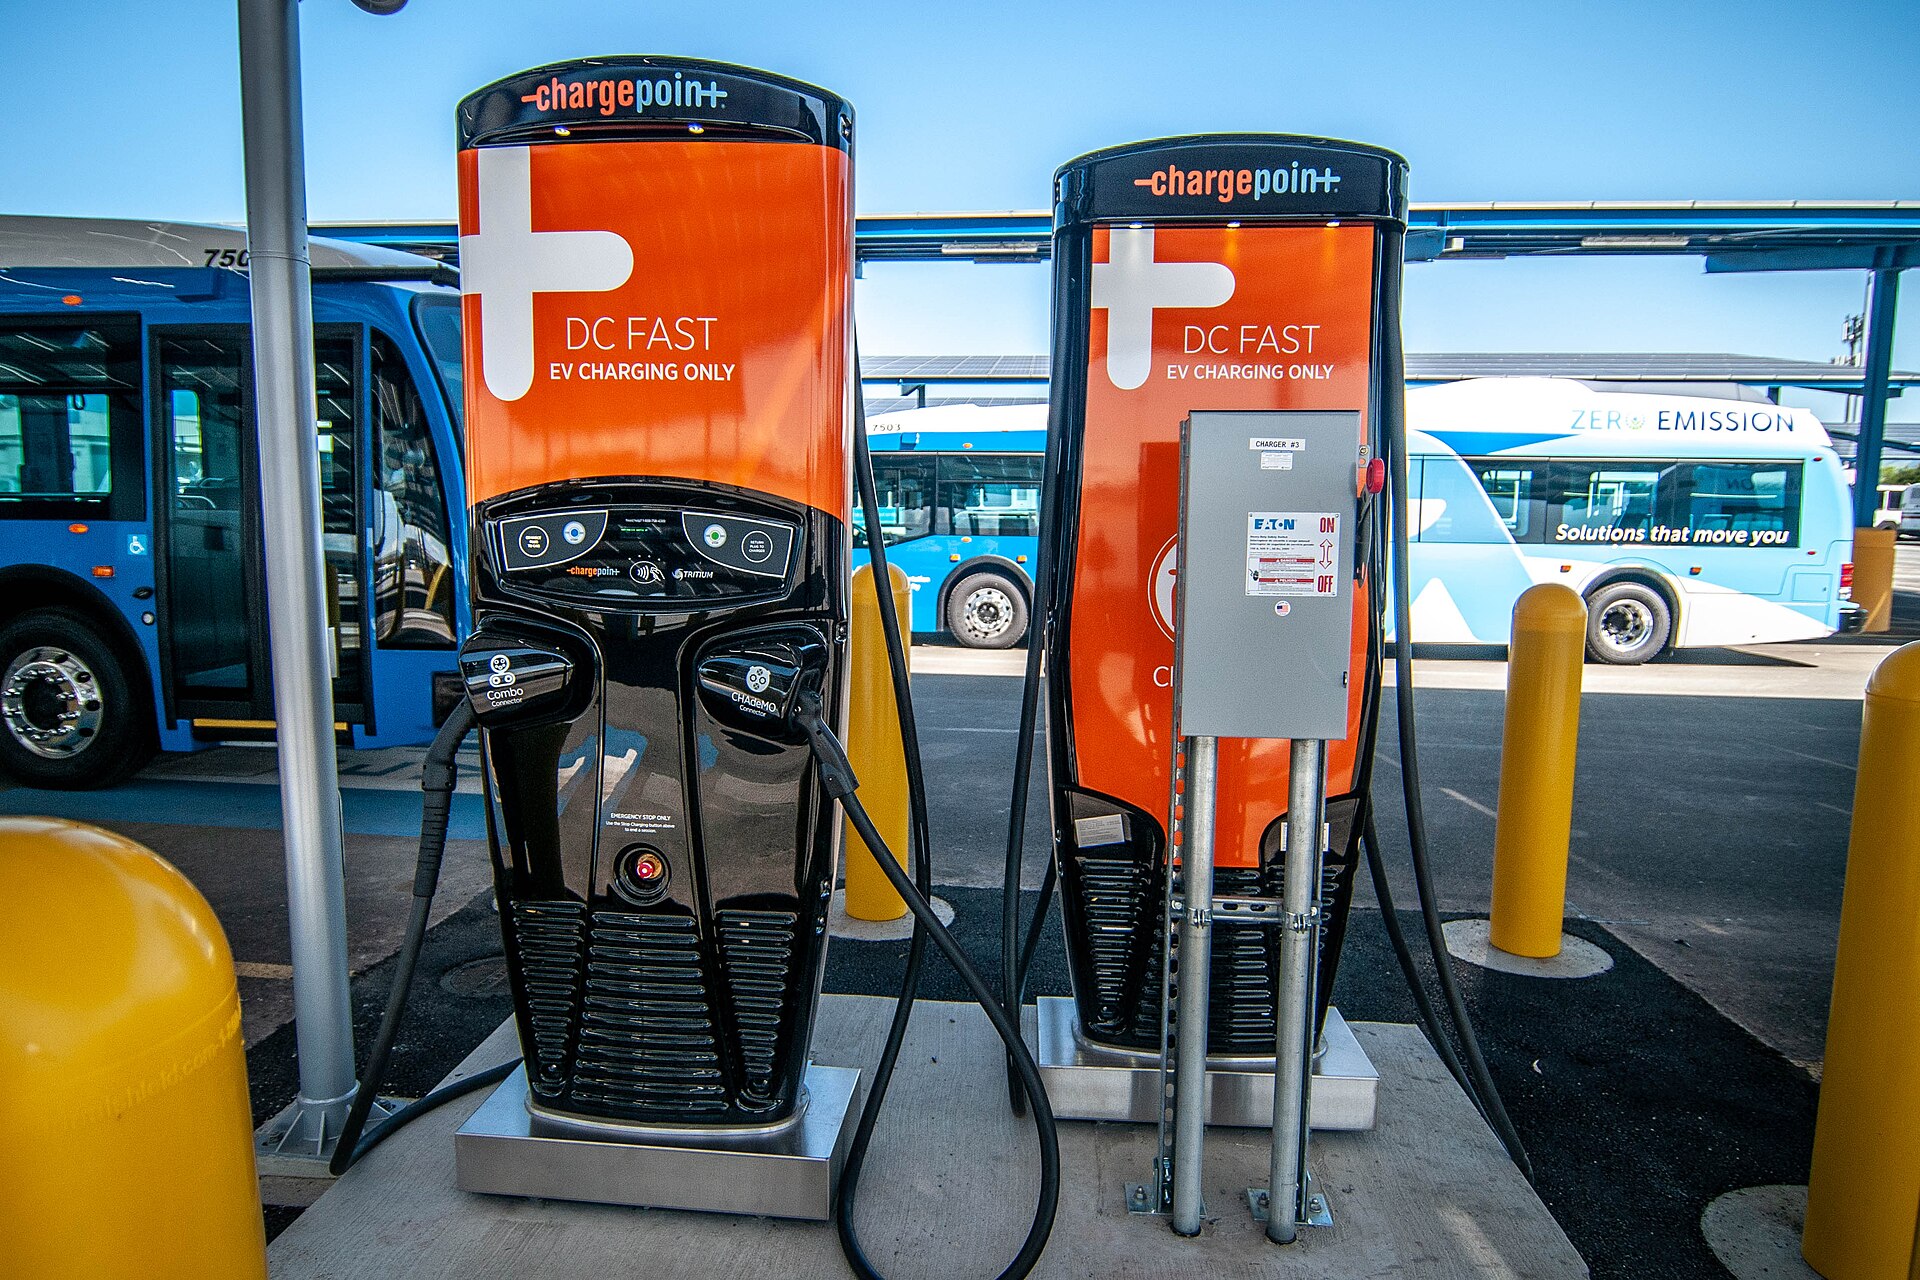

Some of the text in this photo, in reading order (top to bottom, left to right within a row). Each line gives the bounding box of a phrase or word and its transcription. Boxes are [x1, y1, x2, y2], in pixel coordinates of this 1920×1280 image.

[521, 72, 728, 115] chargepoint
[1134, 161, 1341, 202] chargepoint
[566, 317, 718, 351] DC FAST
[1183, 325, 1321, 354] DC FAST
[550, 362, 736, 381] EV CHARGING ONLY
[1167, 364, 1334, 380] EV CHARGING ONLY
[872, 423, 901, 431] 7503
[1658, 410, 1794, 432] EMISSION
[1255, 440, 1287, 448] CHARGER
[1254, 518, 1295, 530] EATON
[1319, 517, 1335, 533] ON
[1555, 523, 1790, 547] Solutions that move you
[566, 566, 620, 578] chargepoint
[683, 570, 714, 579] TRITIUM
[1317, 575, 1334, 593] OFF
[486, 687, 524, 701] Combo
[731, 691, 777, 713] CHAdeMO
[491, 697, 523, 708] Connector
[739, 704, 767, 718] Connector
